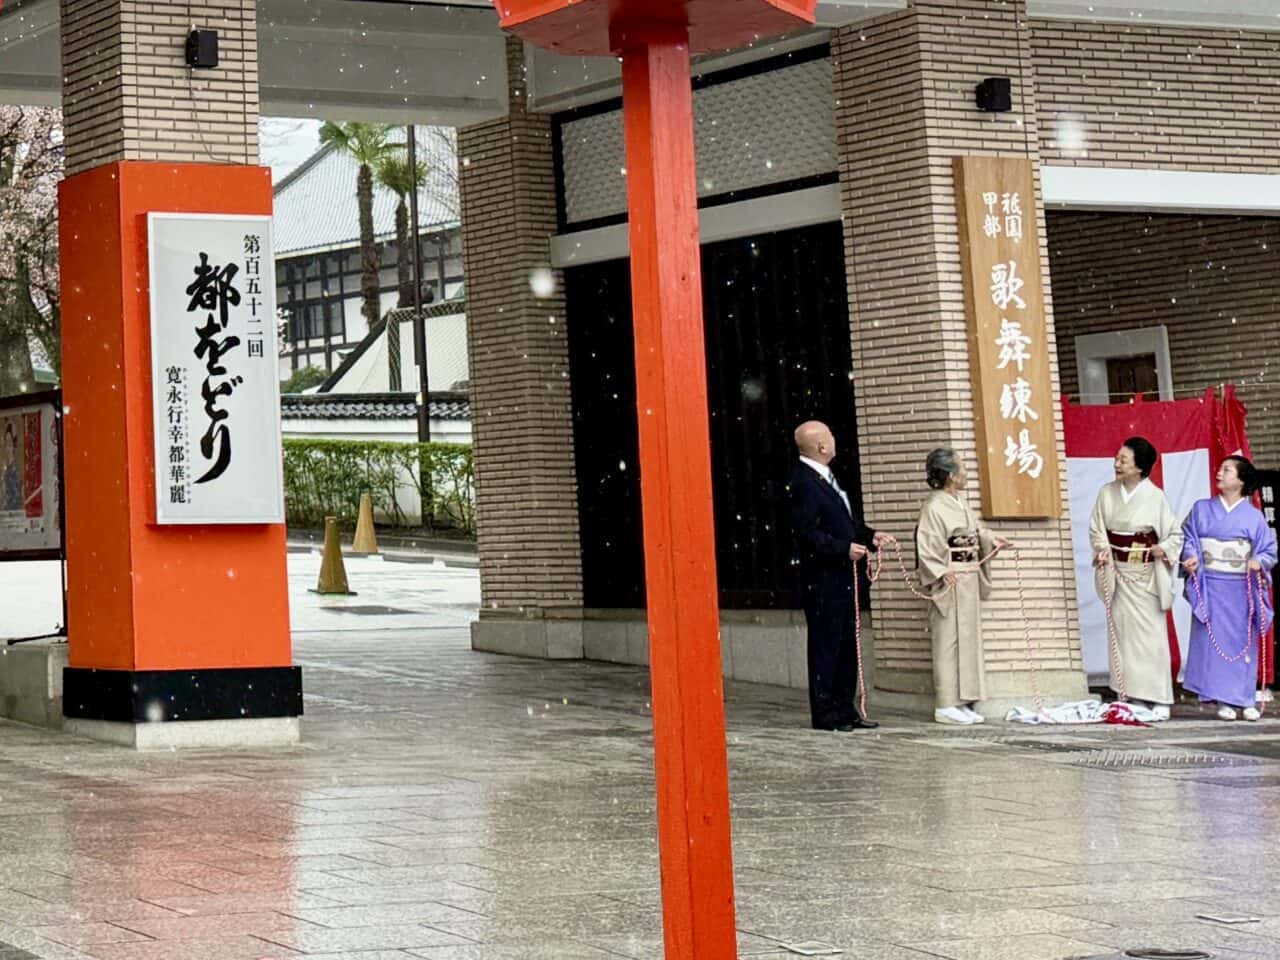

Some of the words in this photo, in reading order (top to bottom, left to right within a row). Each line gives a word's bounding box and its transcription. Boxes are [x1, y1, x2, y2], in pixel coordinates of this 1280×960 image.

[186, 252, 243, 484] 都をどり
[243, 234, 264, 358] 第百五十二回
[990, 258, 1043, 479] 歌舞練場
[165, 365, 186, 504] 寛永行幸都華麗
